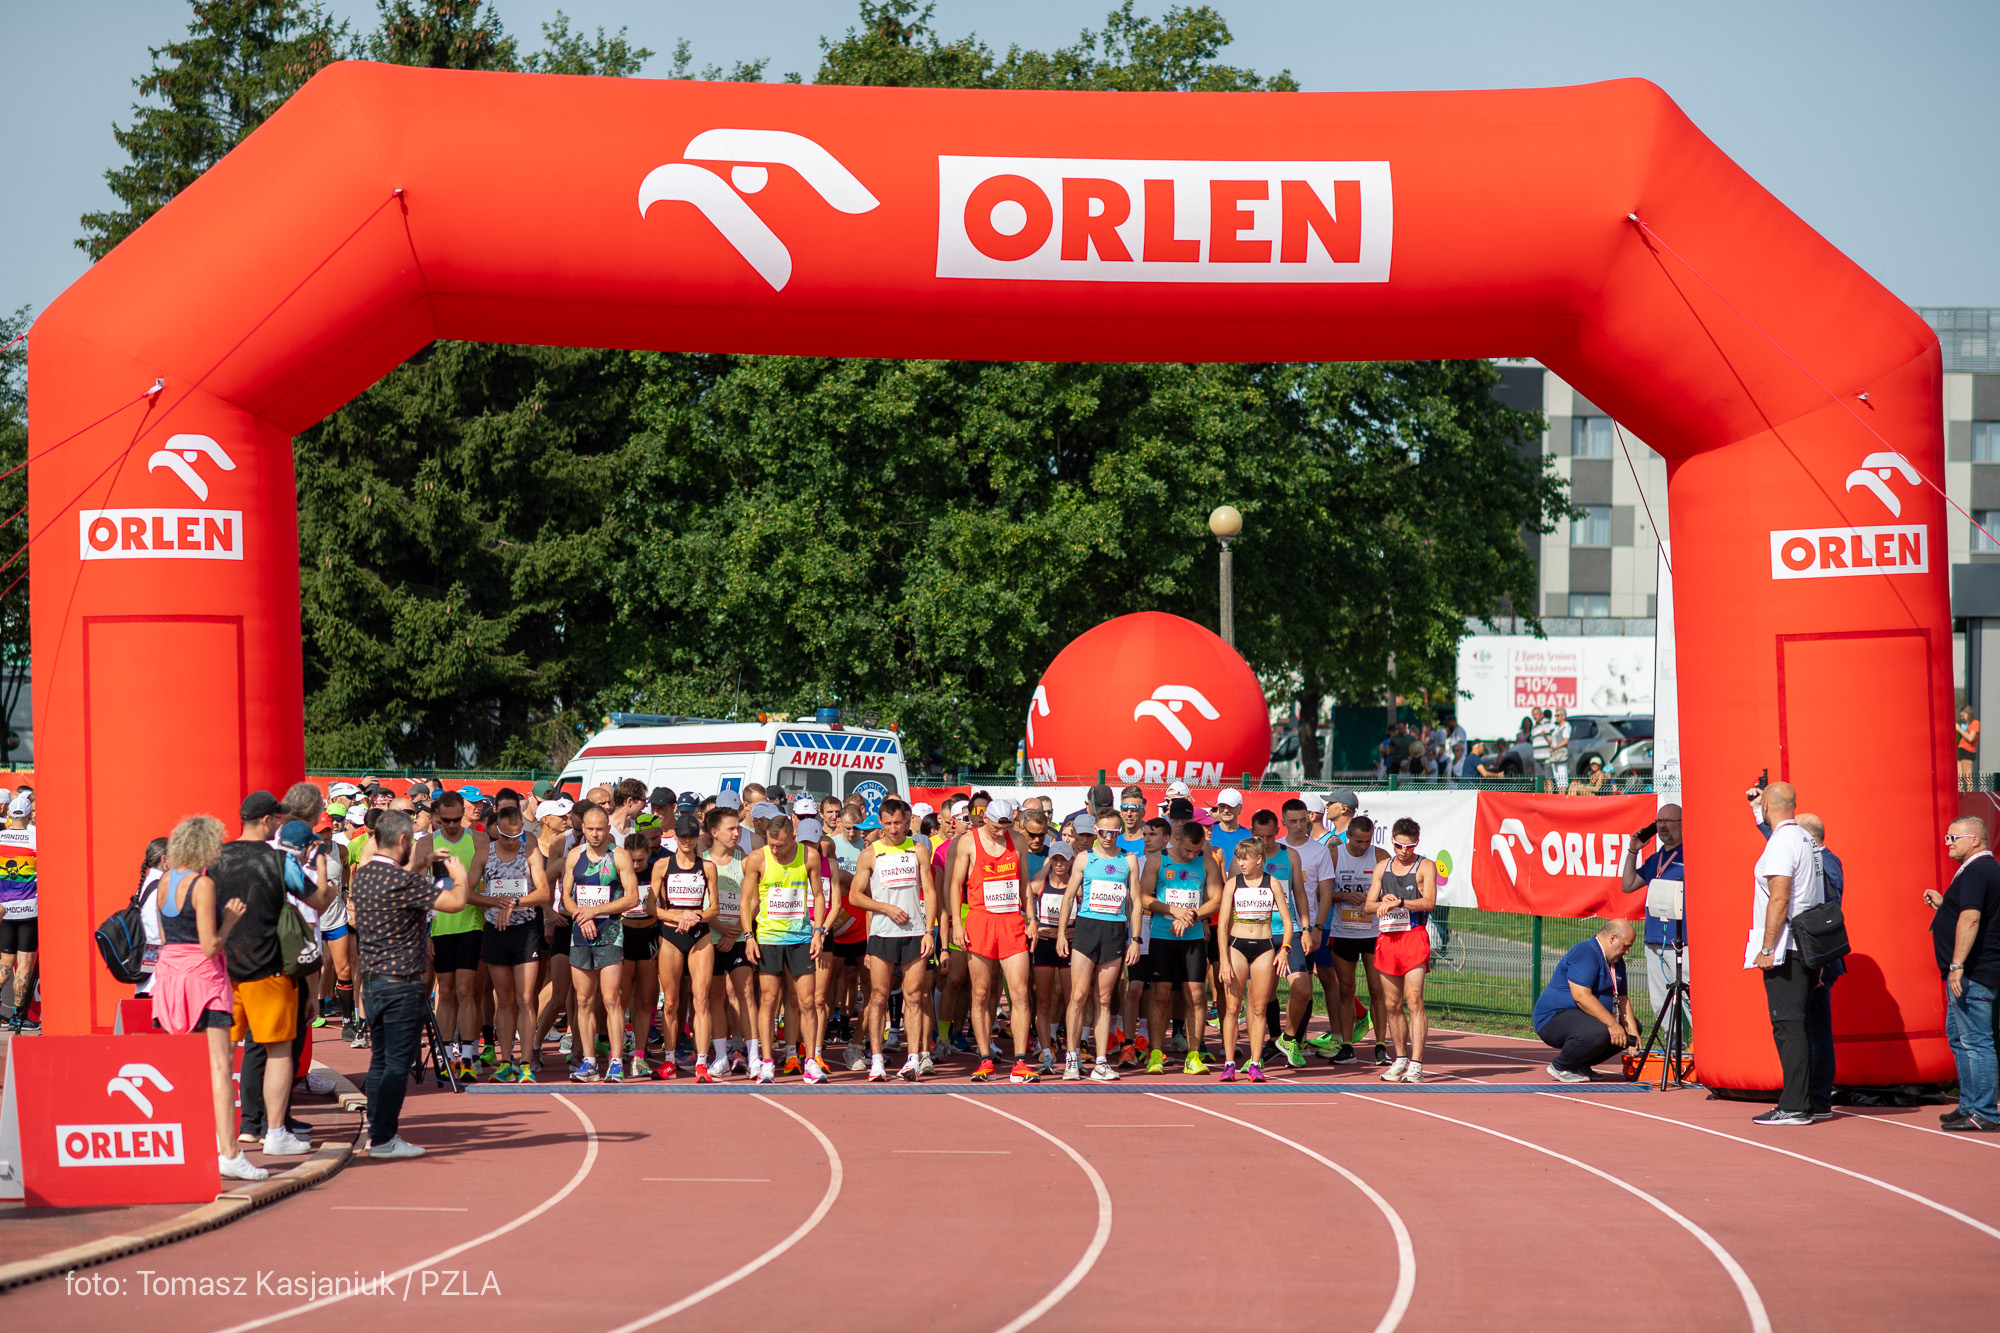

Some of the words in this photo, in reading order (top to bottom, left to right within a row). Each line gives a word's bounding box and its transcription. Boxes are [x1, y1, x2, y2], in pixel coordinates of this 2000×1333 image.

[964, 174, 1362, 263] ORLEN
[88, 516, 233, 552] ORLEN
[1780, 532, 1921, 571] ORLEN
[1516, 693, 1575, 706] RABATU
[790, 750, 885, 770] AMBULANS
[1028, 757, 1057, 782] LEN
[1117, 758, 1224, 786] ORLEN
[855, 783, 886, 794] OWNICT
[900, 855, 909, 863] 22
[1006, 881, 1014, 889] 15
[728, 892, 737, 900] 21
[719, 902, 741, 912] CZYŃSKI
[769, 900, 803, 909] DĄBROWSKI
[1236, 900, 1272, 908] NIEMYJSKA
[65, 1130, 175, 1160] ORLEN
